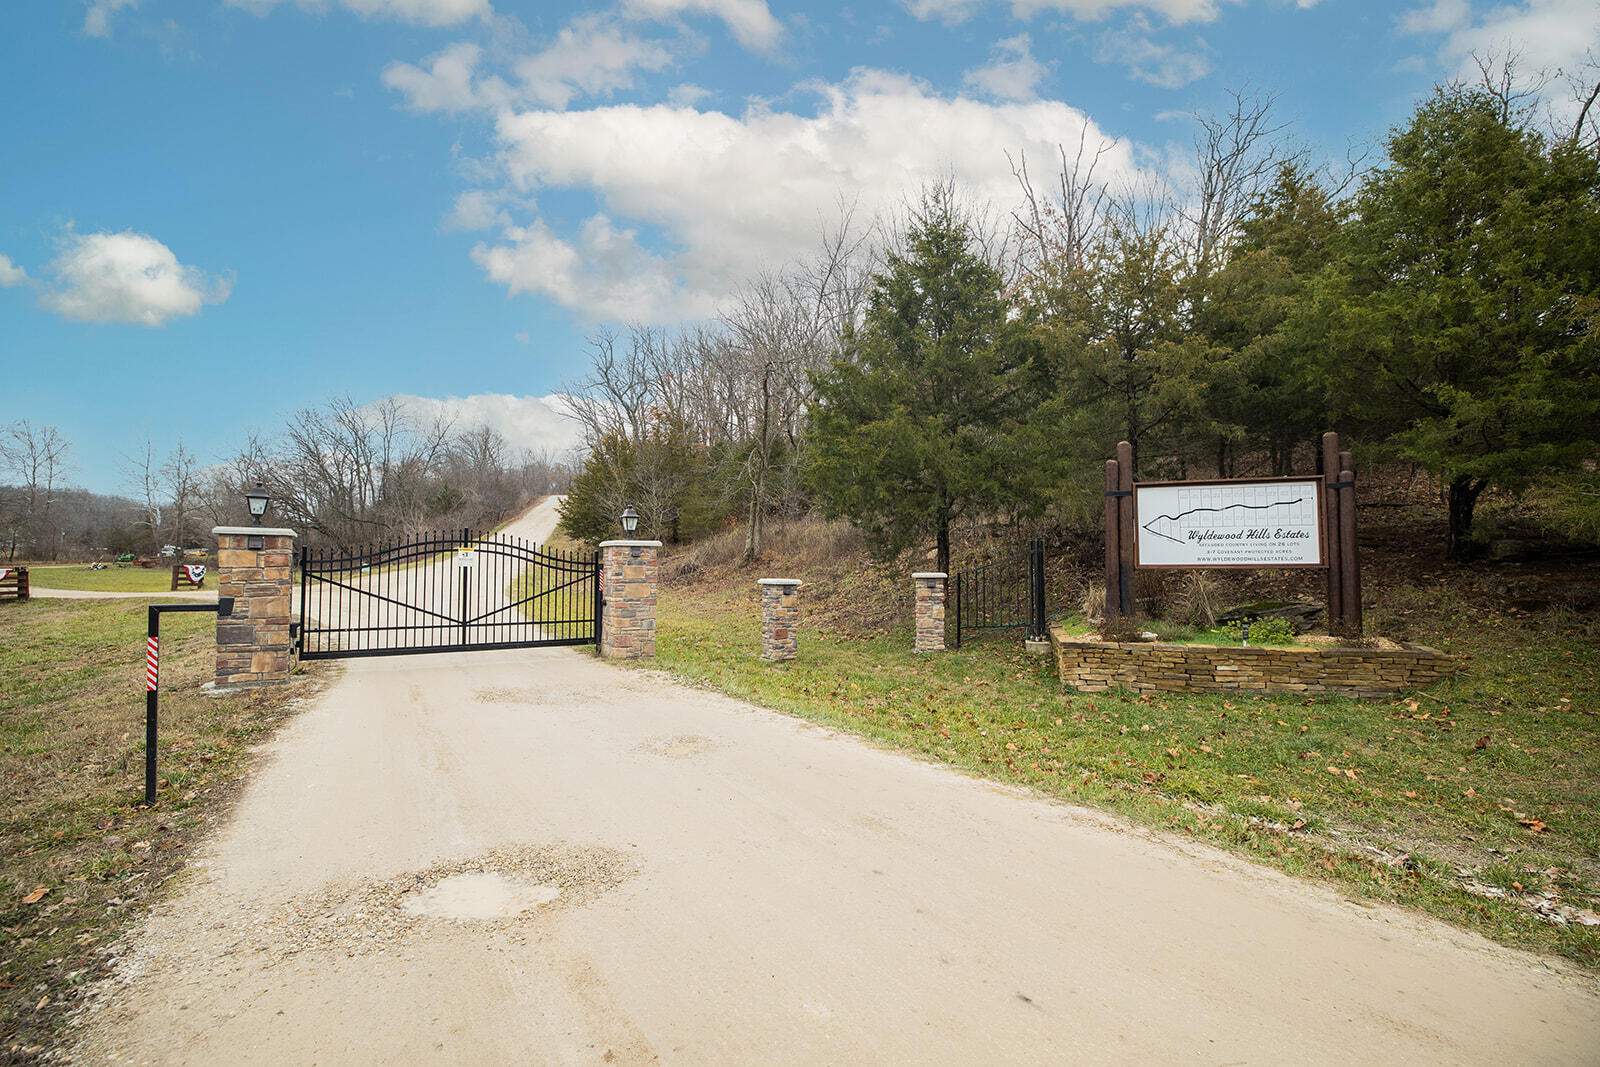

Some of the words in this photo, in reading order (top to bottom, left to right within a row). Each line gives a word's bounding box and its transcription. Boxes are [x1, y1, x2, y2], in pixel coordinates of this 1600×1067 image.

[1188, 529, 1244, 544] Wyldewood
[1246, 528, 1270, 539] Hills
[1274, 528, 1310, 539] Estates
